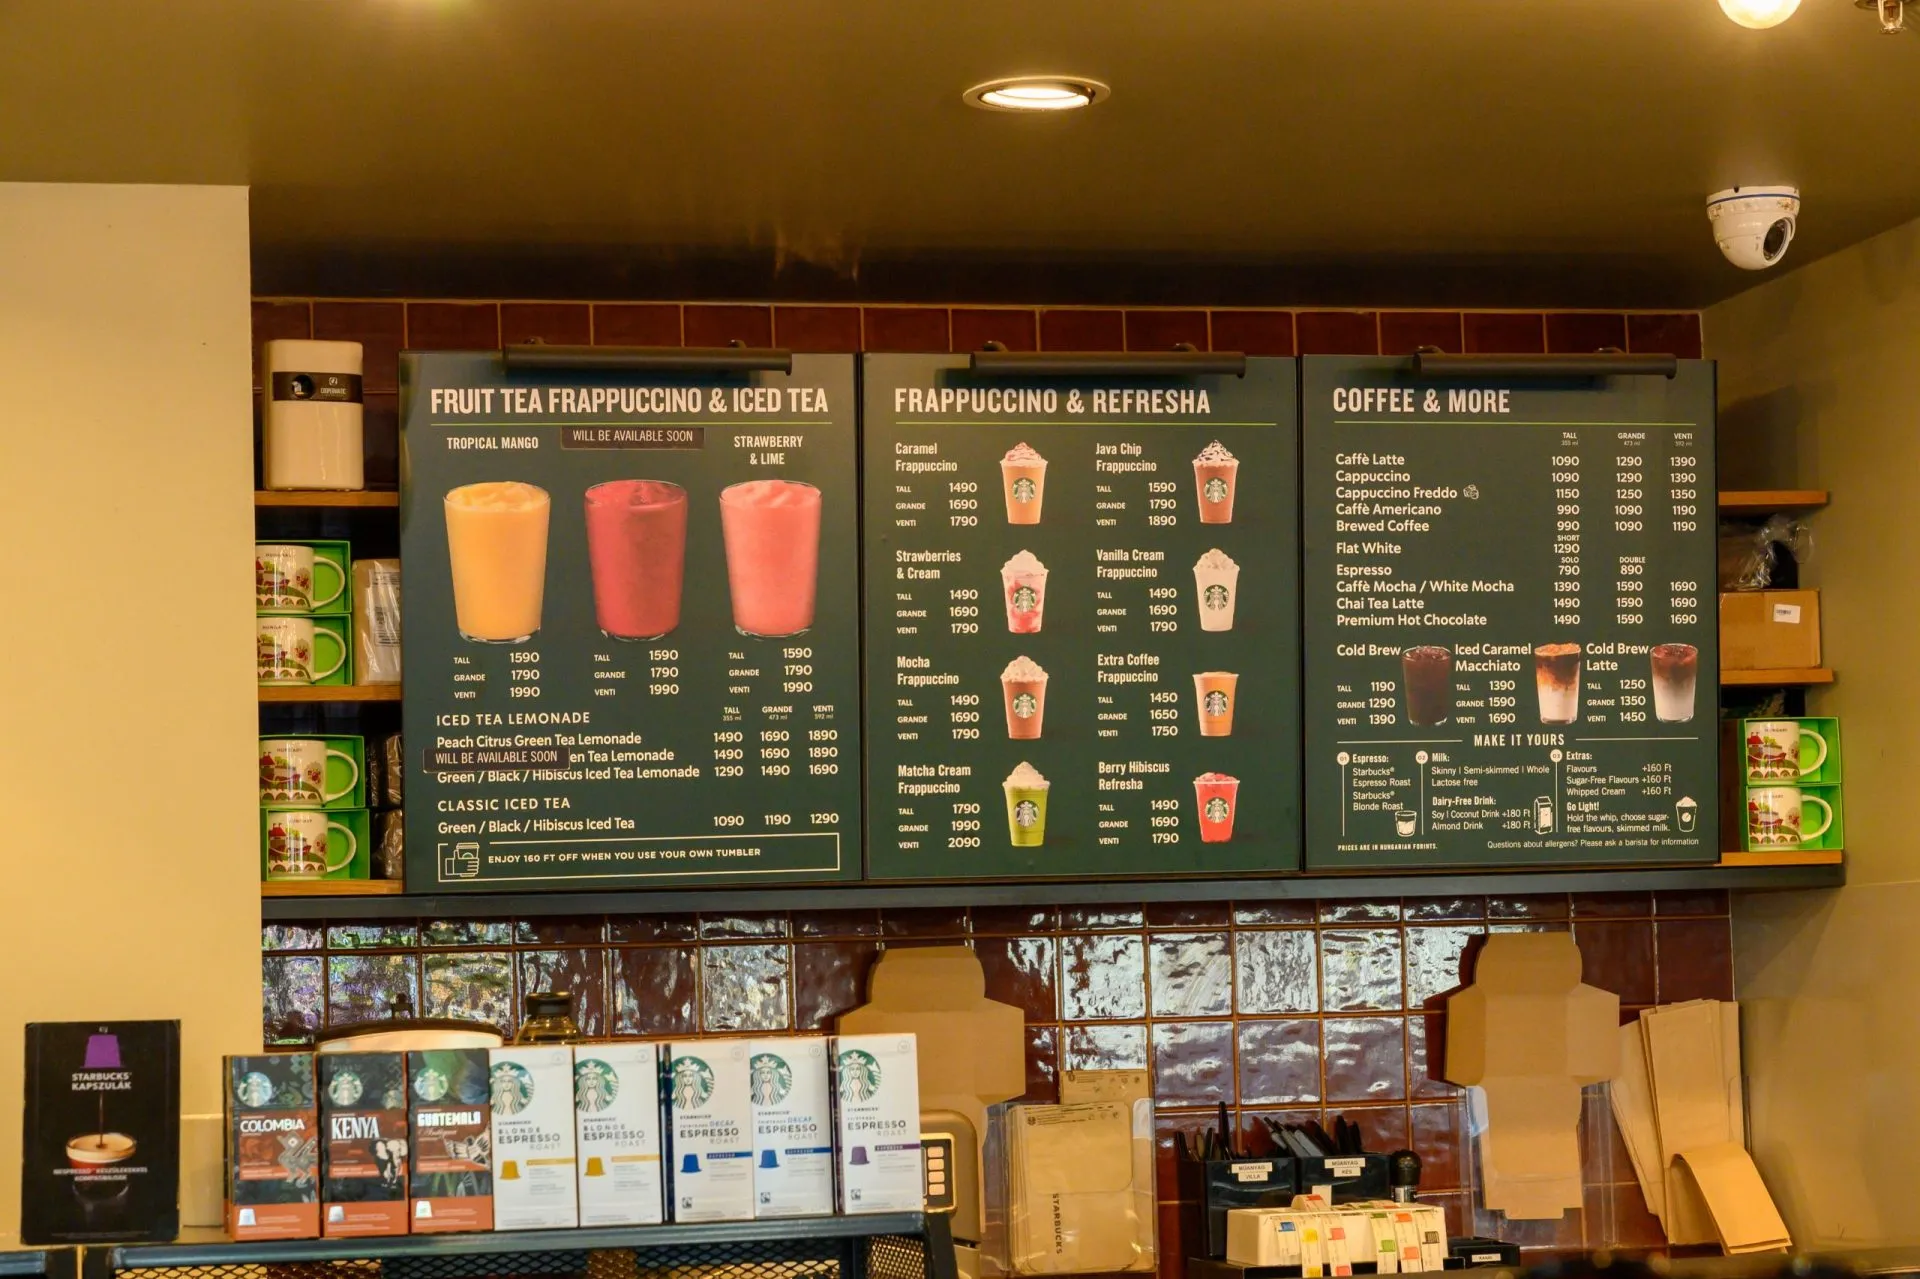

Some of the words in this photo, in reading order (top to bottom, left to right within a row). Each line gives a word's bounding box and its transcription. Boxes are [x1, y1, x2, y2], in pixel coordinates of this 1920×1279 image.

[431, 389, 494, 414] FRUIT
[500, 389, 543, 413] TEA
[549, 388, 701, 413] FRAPPUCCINO
[709, 388, 727, 413] &
[734, 388, 781, 412] ICED
[787, 388, 828, 412] TEA
[895, 388, 1057, 413] FRAPPUCCINO
[1066, 390, 1084, 413] &
[1093, 390, 1210, 414] REFRESHA
[1334, 388, 1414, 412] COFFEE
[1423, 389, 1440, 413] &
[1449, 390, 1510, 413] MORE
[573, 430, 595, 441] WILL
[598, 430, 610, 441] BE
[614, 430, 663, 441] AVAILABLE
[667, 430, 693, 441] SOON
[734, 436, 803, 447] STRAWBERRY
[1563, 432, 1577, 440] TALL
[447, 437, 498, 449] TROPICAL
[502, 437, 538, 448] MANGO
[896, 442, 937, 454] Caramel
[1096, 443, 1117, 454] Java
[1121, 443, 1141, 457] Chip
[750, 453, 757, 465] &
[761, 453, 785, 464] LIME
[1336, 453, 1369, 465] Caffè
[1373, 454, 1404, 465] Latte
[1552, 456, 1579, 466] 1090
[1616, 456, 1642, 466] 1290
[1671, 457, 1696, 466] 1390
[896, 460, 957, 474] Frappuccino
[1096, 460, 1156, 473] Frappuccino
[1336, 503, 1370, 515] Caffè
[1373, 503, 1441, 515] Americano
[1557, 505, 1580, 515] 990
[1615, 505, 1642, 515] 1090
[1673, 505, 1696, 515] 1190
[1337, 542, 1359, 554] Flat
[1362, 542, 1401, 553] White
[1554, 543, 1580, 553] 1290
[896, 550, 961, 562] Strawberries
[1096, 549, 1129, 561] Vanilla
[1132, 549, 1164, 561] Cream
[897, 567, 904, 579] &
[908, 567, 940, 579] Cream
[1097, 566, 1157, 580] Frappuccino
[1337, 564, 1392, 578] Espresso
[1558, 565, 1580, 575] 790
[1621, 565, 1643, 575] 890
[1337, 644, 1365, 656] Cold
[1369, 644, 1401, 655] Brew
[454, 657, 470, 665] TALL
[510, 652, 539, 663] 1590
[897, 656, 930, 668] Mocha
[454, 674, 485, 682] GRANDE
[512, 670, 540, 680] 1790
[898, 673, 959, 687] Frappuccino
[454, 691, 475, 699] VENTI
[510, 687, 540, 697] 1990
[437, 715, 470, 726] ICED
[476, 714, 502, 725] TEA
[509, 712, 589, 724] LEMONADE
[437, 736, 473, 748] Peach
[477, 735, 512, 747] Citrus
[514, 735, 552, 746] Green
[555, 734, 575, 745] Tea
[579, 732, 641, 745] Lemonade
[1474, 734, 1505, 746] MAKE
[1512, 734, 1521, 746] IT
[1527, 734, 1564, 746] YOURS
[1353, 754, 1388, 764] Espresso:
[1432, 753, 1449, 762] Milk:
[1566, 751, 1592, 760] Extras:
[898, 765, 935, 777] Matcha
[938, 764, 971, 776] Cream
[1099, 762, 1126, 775] Berry
[1129, 761, 1170, 773] Hibiscus
[1567, 765, 1597, 774] Flavours
[1642, 763, 1662, 772] +160
[1664, 763, 1672, 772] Ft
[899, 781, 960, 796] Frappuccino
[1099, 778, 1143, 790] Refresha
[1353, 779, 1387, 788] Espresso
[1390, 778, 1411, 787] Roast
[438, 799, 499, 812] CLASSIC
[505, 798, 538, 810] ICED
[544, 798, 570, 808] TEA
[1567, 802, 1576, 811] Go
[1578, 802, 1599, 812] Light!
[1567, 814, 1584, 823] Hold
[1586, 813, 1598, 822] the
[1600, 813, 1618, 823] whip,
[1621, 813, 1646, 822] choose
[1648, 814, 1669, 823] sugar-
[1567, 825, 1581, 834] free
[1583, 825, 1614, 834] flavours,
[1617, 824, 1650, 833] skimmed
[1653, 824, 1670, 832] milk.
[1488, 841, 1521, 849] Questions
[1523, 841, 1543, 849] about
[1545, 840, 1578, 849] allergens?
[1581, 839, 1602, 847] Please
[1605, 839, 1616, 847] ask
[1625, 839, 1648, 847] barista
[1650, 838, 1659, 846] for
[1662, 838, 1699, 846] information
[489, 855, 520, 864] ENJOY
[524, 855, 540, 863] 160
[544, 854, 555, 862] FT
[559, 853, 578, 862] OFF
[581, 853, 611, 861] WHEN
[615, 852, 634, 860] YOU
[638, 851, 656, 860] USE
[659, 851, 686, 859] YOUR
[689, 850, 713, 858] OWN
[716, 848, 760, 857] TUMBLER
[72, 1073, 130, 1082] STARBUCKS
[72, 1081, 131, 1091] KAPSZULÁK
[418, 1111, 481, 1127] GUATEMALA
[788, 1116, 812, 1124] DECAF
[848, 1120, 906, 1130] ESPRESSO
[240, 1118, 305, 1133] COLOMBIA
[331, 1117, 380, 1139] KENYA
[584, 1124, 626, 1133] BLONDE
[759, 1124, 817, 1134] ESPRESSO
[499, 1133, 560, 1144] ESPRESSO
[584, 1130, 645, 1141] ESPRESSO
[680, 1128, 739, 1138] ESPRESSO
[1053, 1193, 1063, 1254] STARBUCKS
